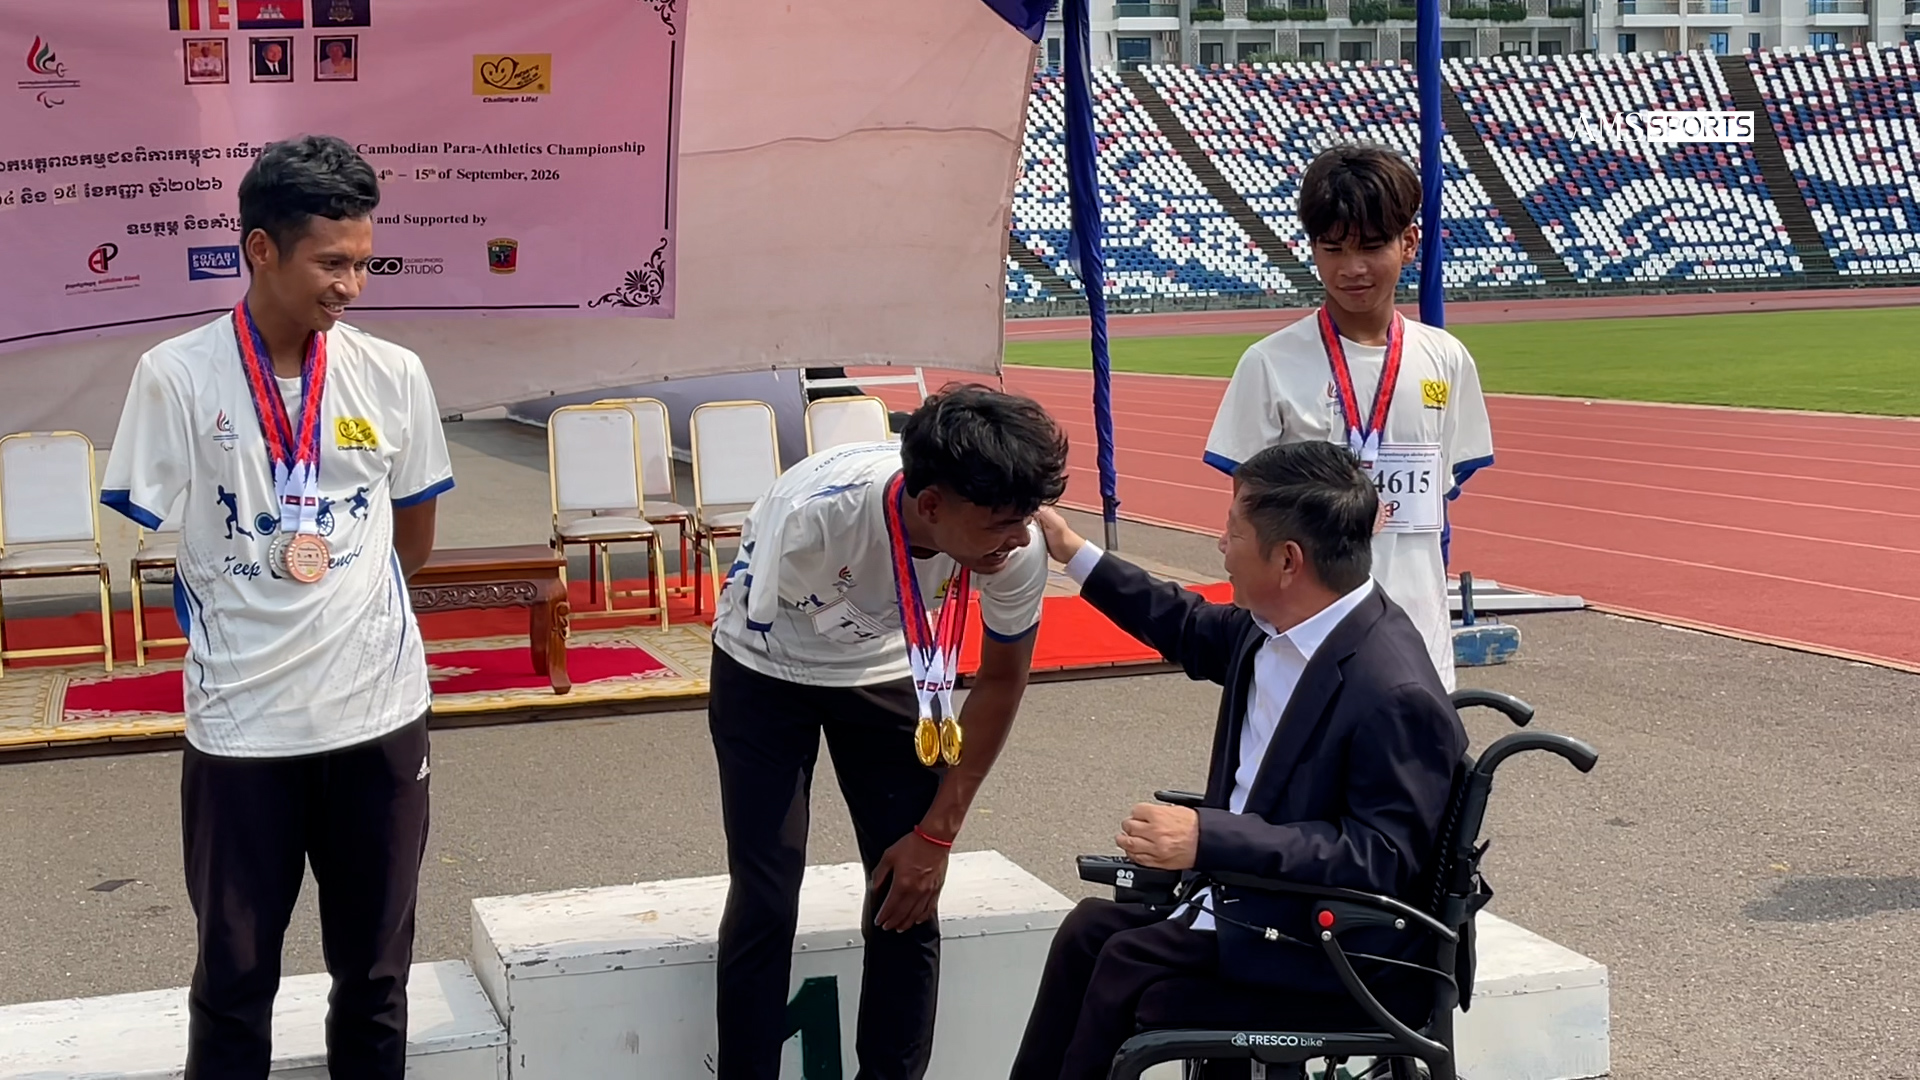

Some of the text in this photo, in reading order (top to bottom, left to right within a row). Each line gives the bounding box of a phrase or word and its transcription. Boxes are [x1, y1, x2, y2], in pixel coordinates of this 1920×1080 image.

[356, 141, 646, 157] Cambodian Para-Athletics Championship
[438, 169, 451, 180] of
[456, 169, 528, 182] September,
[531, 169, 560, 180] 2026
[376, 213, 488, 226] and Supported by
[192, 252, 236, 261] POCARI
[193, 259, 231, 268] SWEAT
[404, 264, 444, 275] STUDIO
[1374, 469, 1431, 494] 4615
[1249, 1035, 1299, 1046] FRESCO
